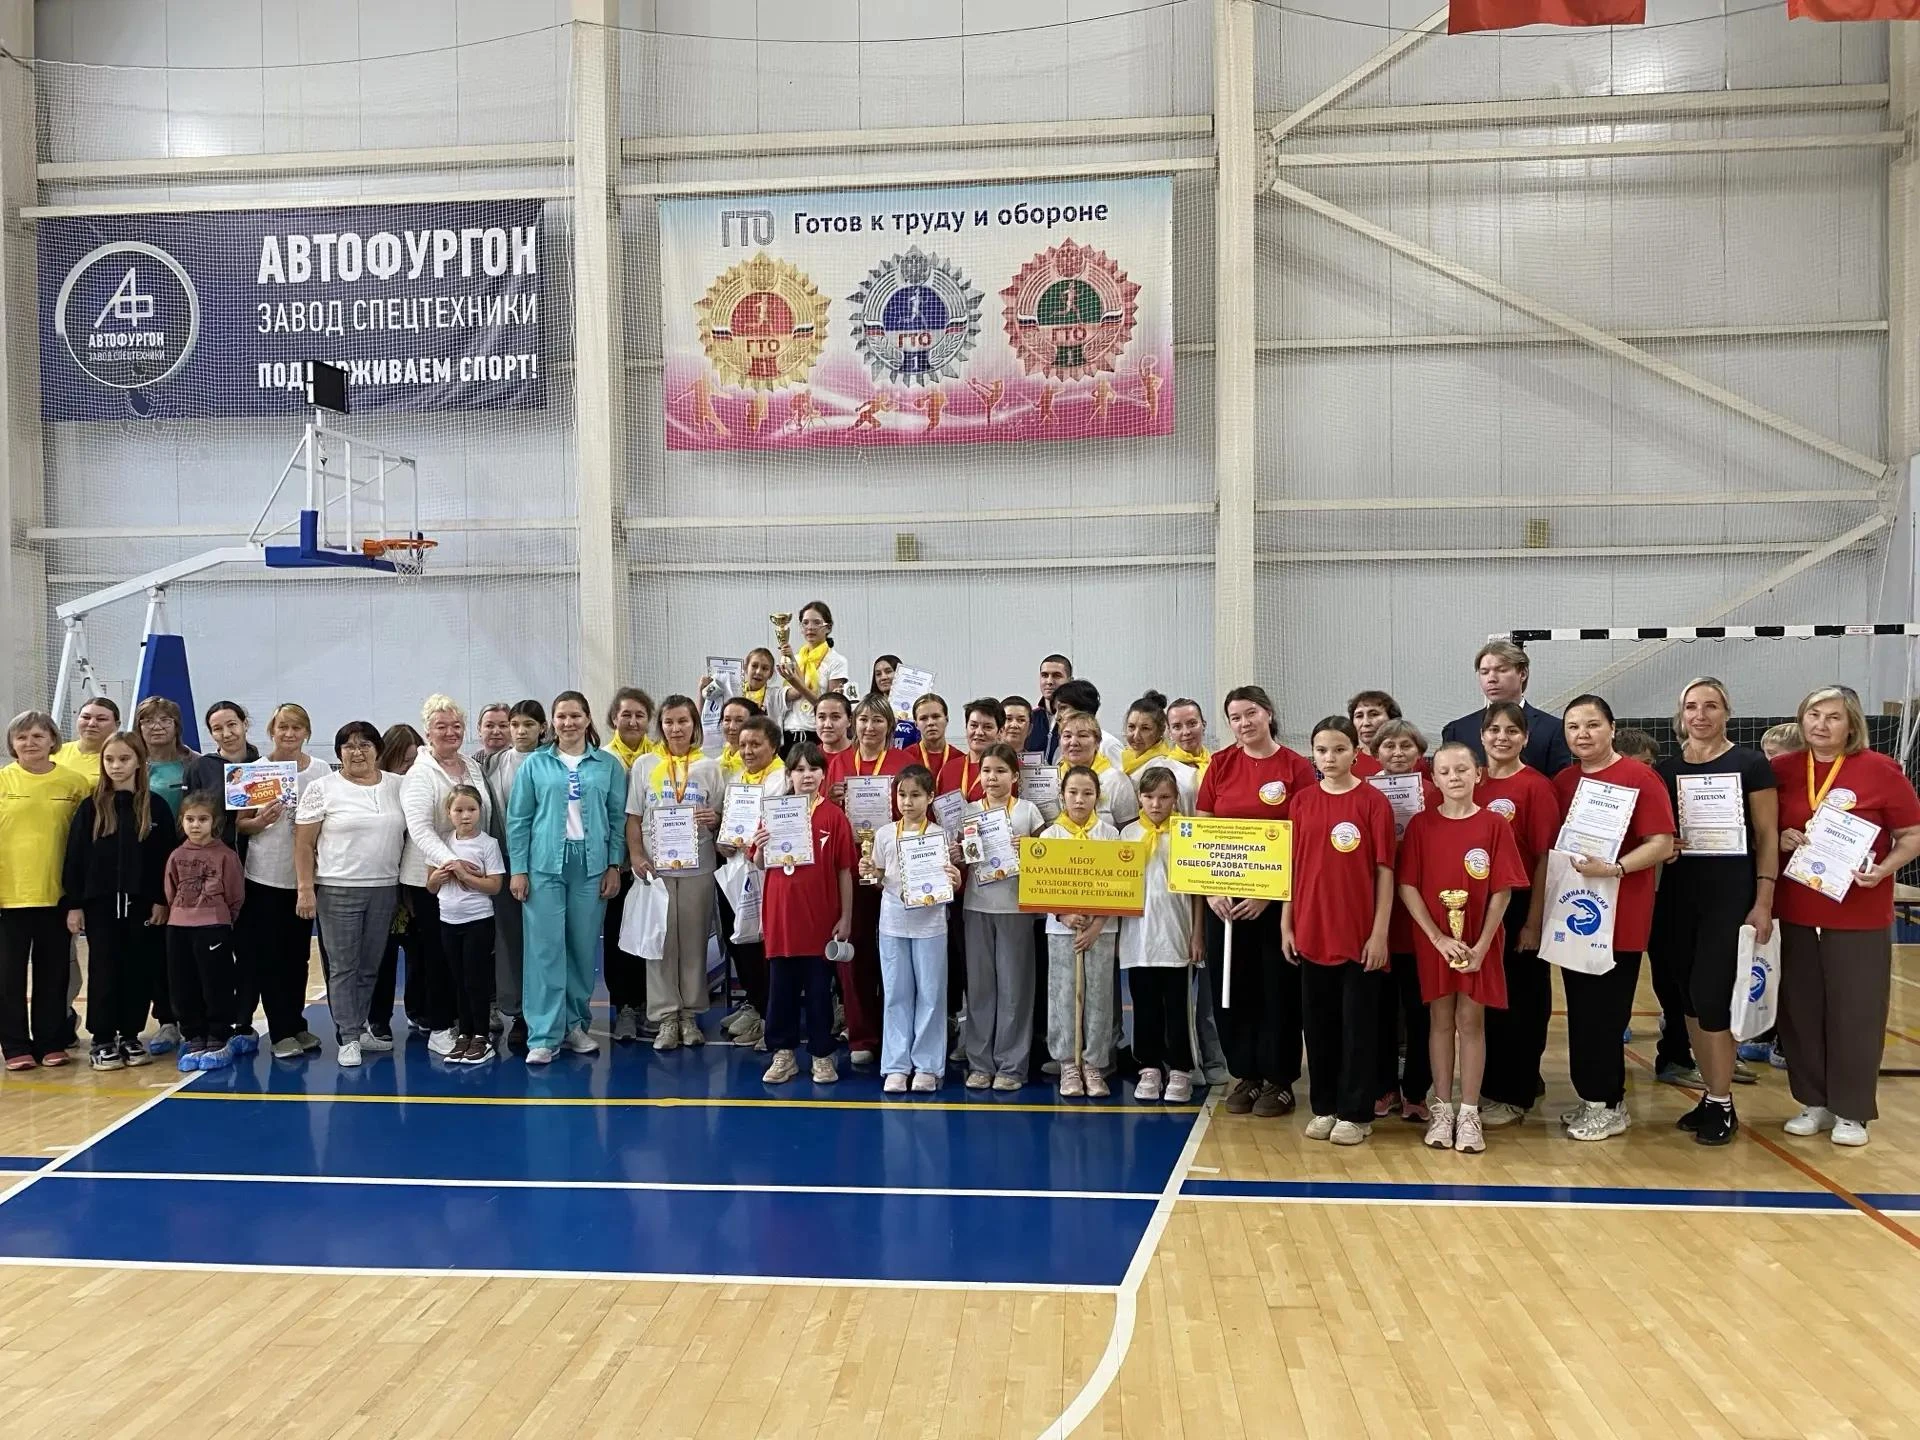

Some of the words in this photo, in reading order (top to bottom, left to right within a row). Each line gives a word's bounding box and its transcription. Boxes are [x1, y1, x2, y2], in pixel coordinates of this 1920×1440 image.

[794, 212, 863, 234] Готов
[871, 216, 885, 231] к
[892, 211, 966, 235] труду
[975, 211, 989, 226] и
[998, 203, 1109, 230] обороне
[721, 209, 775, 247] ГТО
[257, 226, 537, 284] АВТОФУРГОН
[257, 300, 344, 336] ЗАВОД
[353, 293, 537, 334] СПЕЦТЕХНИКИ
[88, 331, 165, 348] АВТОФУРГОН
[898, 332, 931, 348] ГТО
[1052, 326, 1087, 341] ГТО
[747, 338, 780, 353] ГТО
[89, 352, 113, 361] ЗАВОД
[113, 350, 165, 361] СПЕЦТЕХНИКИ
[258, 357, 450, 391] ПОДЖИВАЕМ
[459, 353, 538, 382] СПОРТ!
[1588, 798, 1620, 810] ДИПЛОМ
[1824, 827, 1857, 845] ДИПЛОМ
[1193, 842, 1266, 852] «ТЮРЛЕМИНСКАЯ
[1068, 856, 1096, 865] МБОУ
[1209, 852, 1248, 860] СРЕДНЯЯ
[1177, 859, 1283, 871] ОБЩЕОБРАЗОВАТЕЛЬНАЯ
[1211, 869, 1246, 878] ШКОЛА»
[1036, 879, 1094, 888] КОЗЛОВСКОГО
[1028, 887, 1079, 896] ЧУВАШСКОЙ
[1080, 889, 1135, 898] РЕСПУБЛИКИ
[1558, 889, 1586, 905] ЕДИНАЯ
[1586, 889, 1609, 910] РОССИЯ
